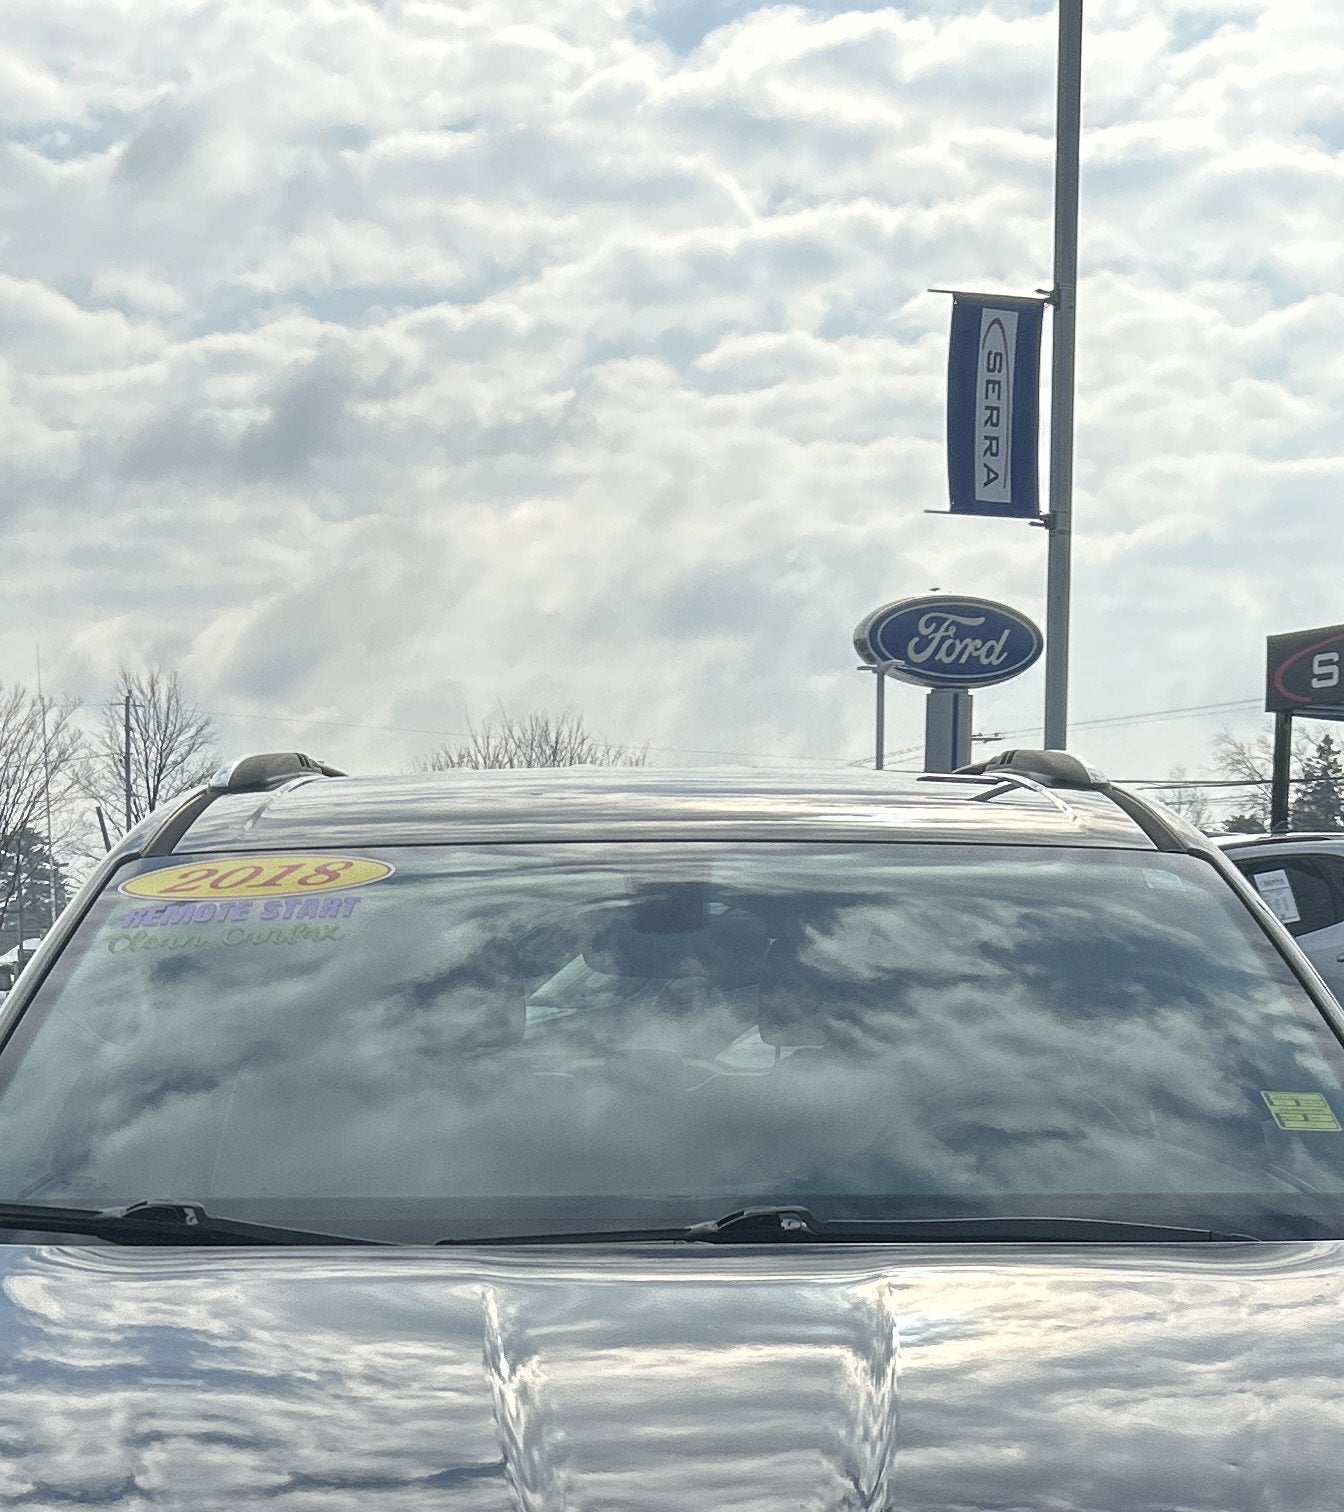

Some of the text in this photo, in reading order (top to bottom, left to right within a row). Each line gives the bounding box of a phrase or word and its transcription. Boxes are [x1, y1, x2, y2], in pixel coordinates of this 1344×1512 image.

[982, 349, 1004, 489] SERRA
[907, 611, 1011, 665] Ford
[158, 861, 353, 893] 2018
[121, 897, 361, 929] REMOTE START
